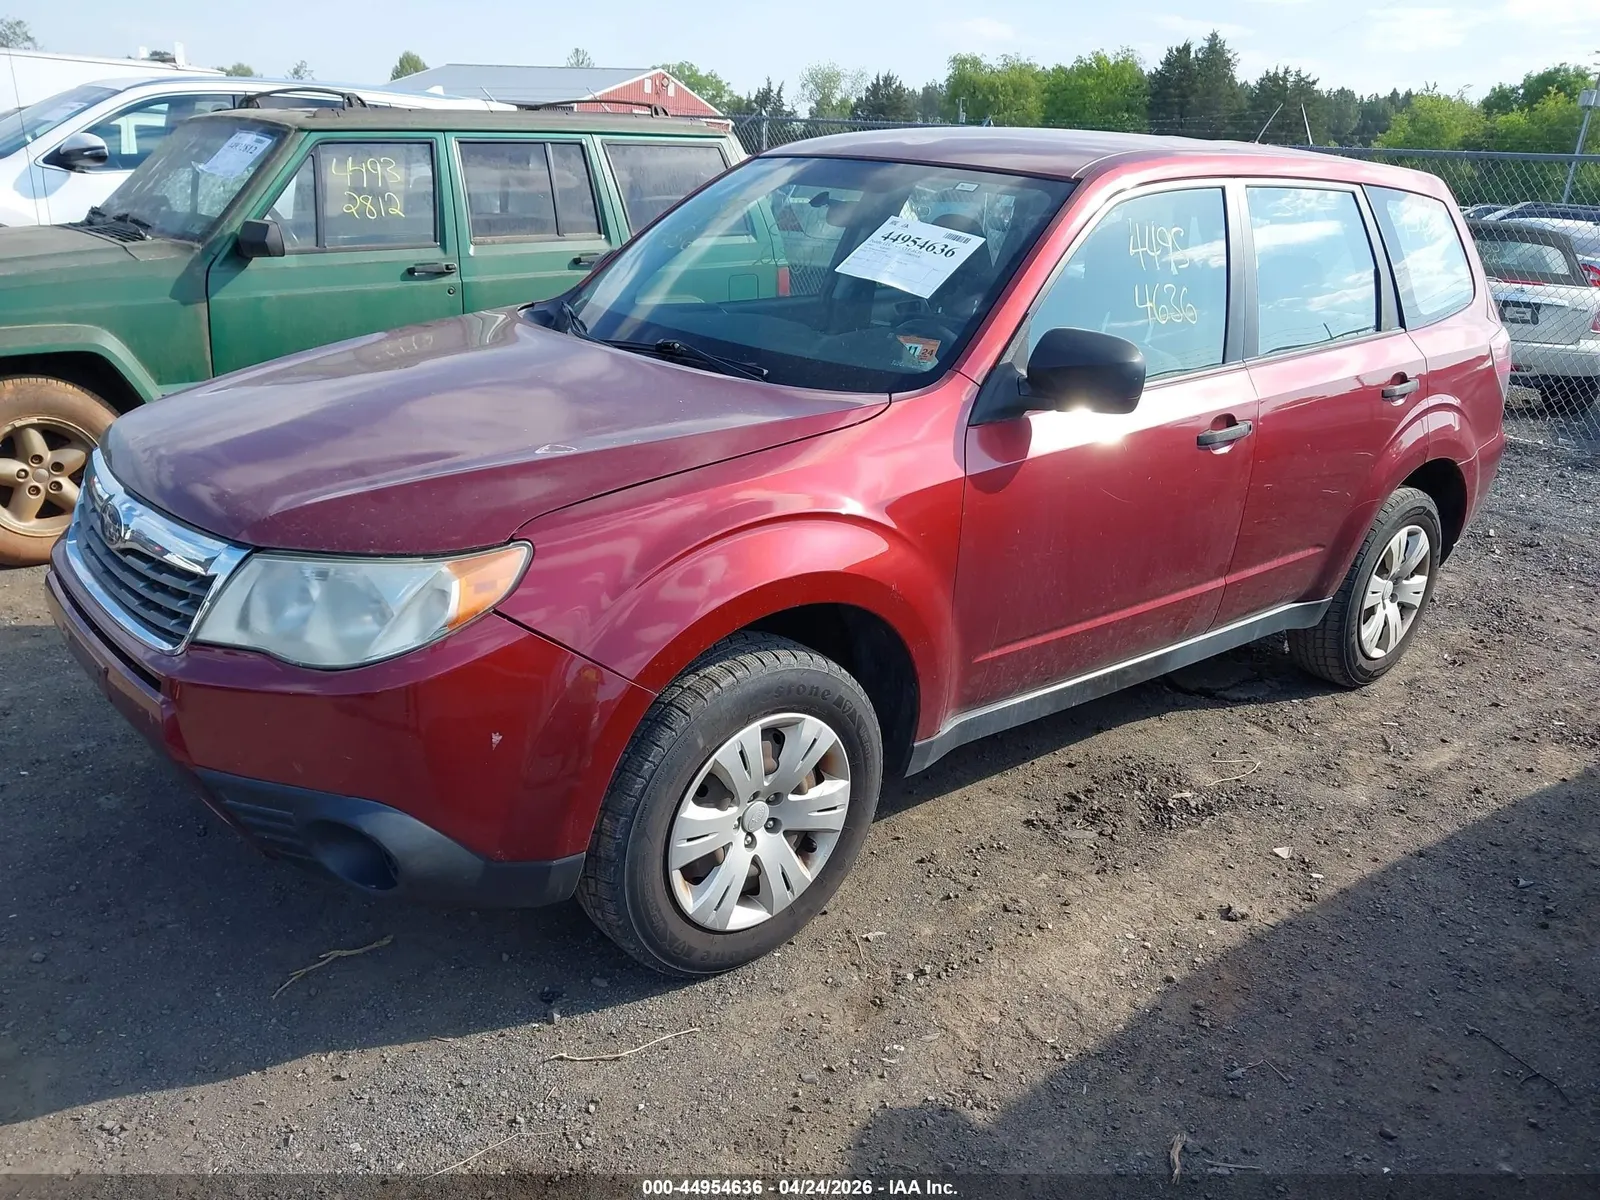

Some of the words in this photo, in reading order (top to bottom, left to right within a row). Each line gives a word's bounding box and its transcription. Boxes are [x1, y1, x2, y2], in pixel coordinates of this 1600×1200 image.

[331, 156, 401, 187] 4493
[342, 191, 406, 219] 2812
[881, 230, 958, 258] 44954636
[1134, 283, 1198, 326] 4636
